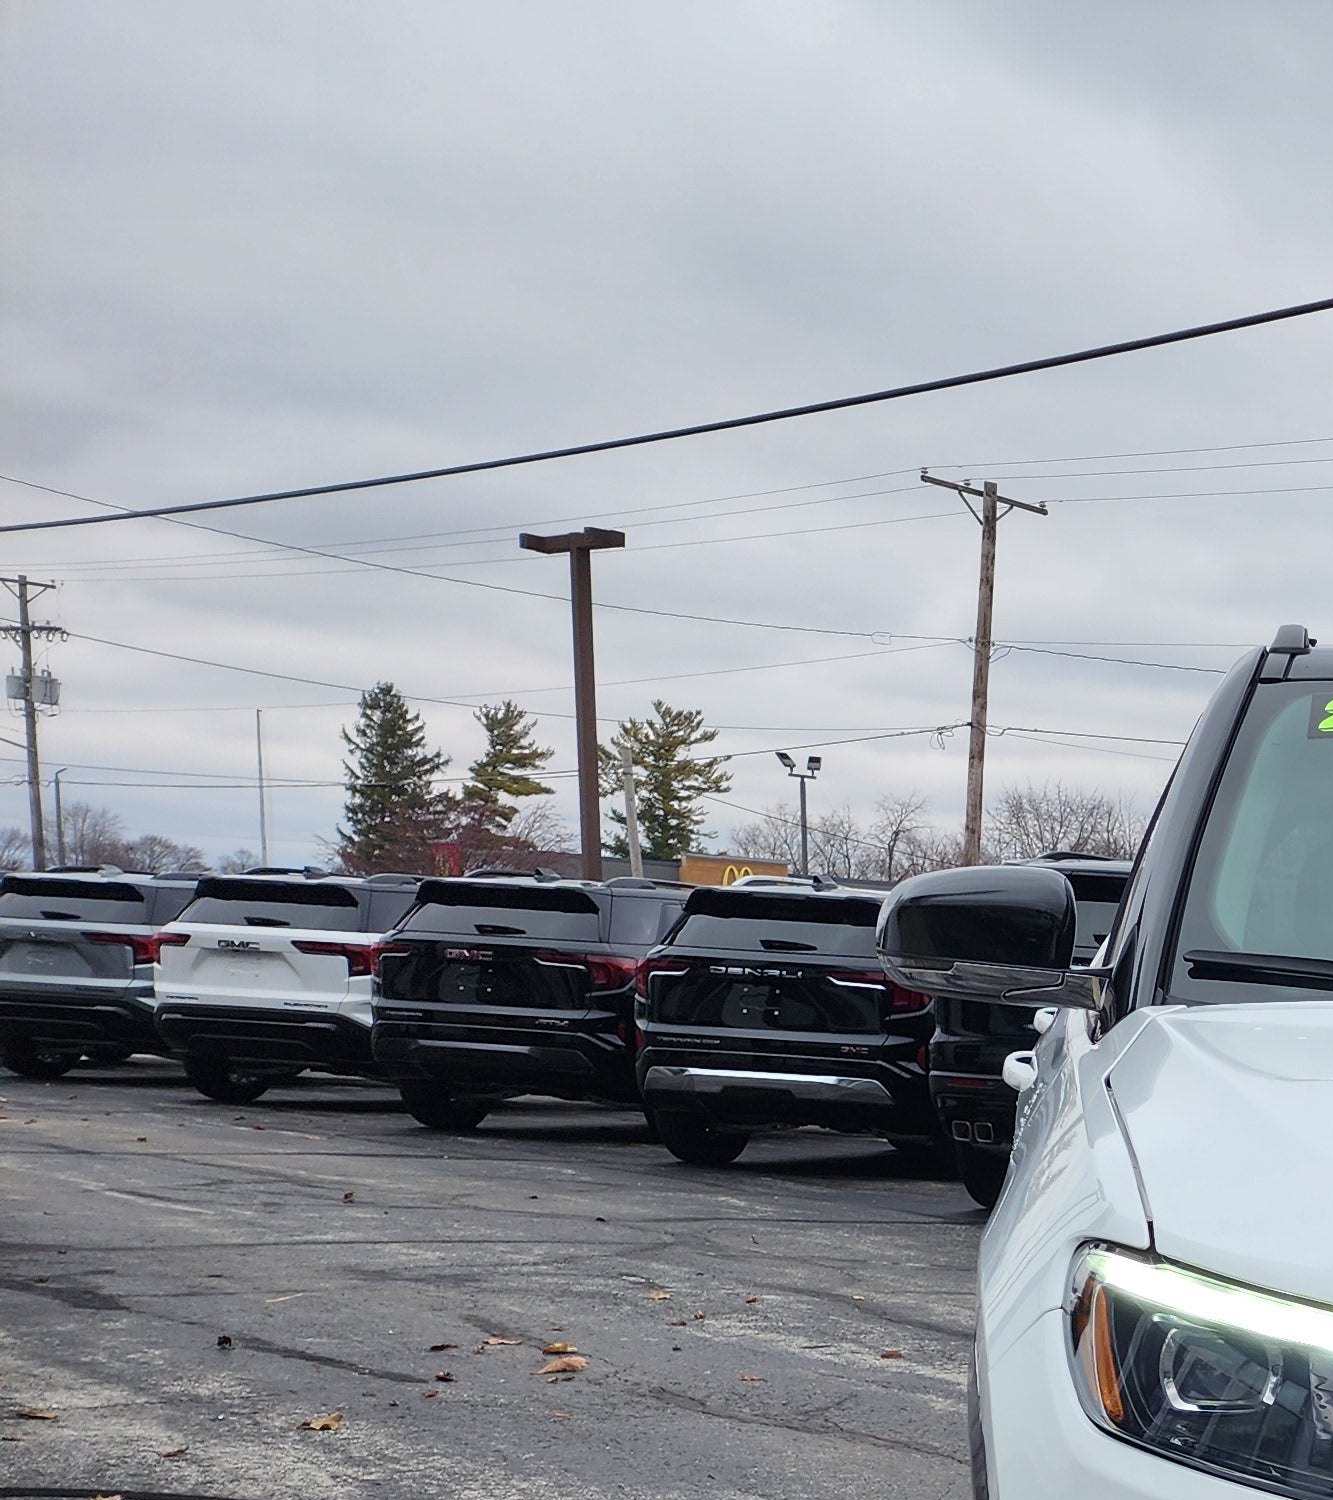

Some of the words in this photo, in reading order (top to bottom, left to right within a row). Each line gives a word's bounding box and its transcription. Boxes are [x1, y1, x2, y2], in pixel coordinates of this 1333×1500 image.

[217, 939, 261, 951] GMC
[445, 948, 493, 960] GMC
[709, 965, 803, 979] DENALI
